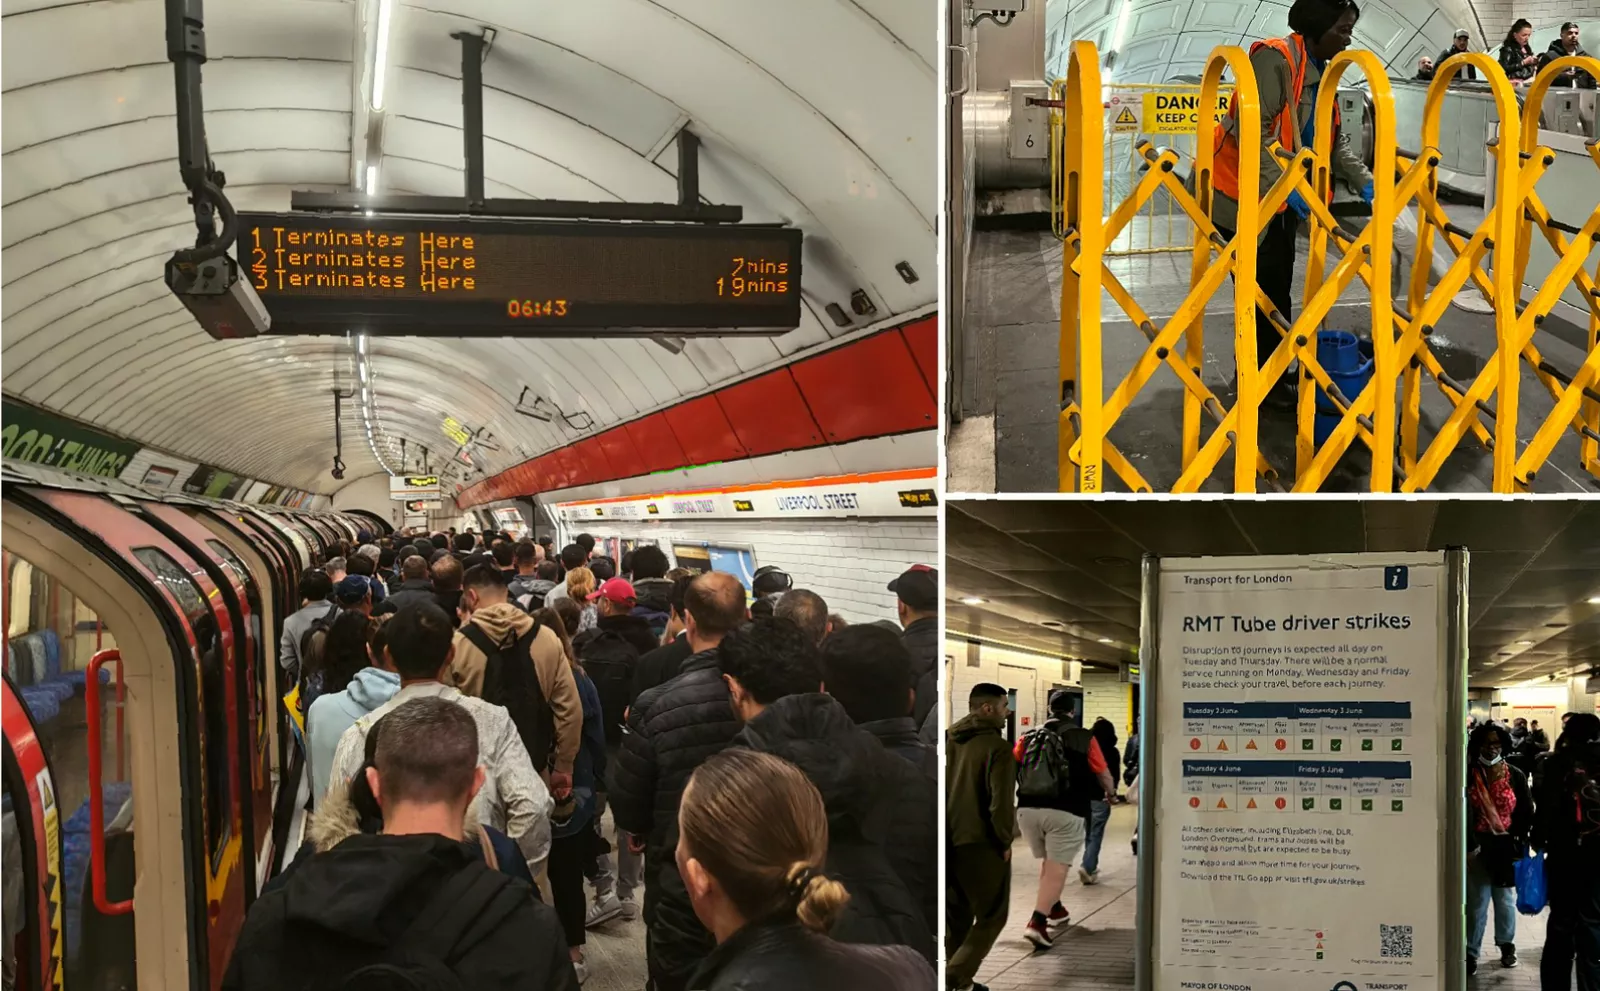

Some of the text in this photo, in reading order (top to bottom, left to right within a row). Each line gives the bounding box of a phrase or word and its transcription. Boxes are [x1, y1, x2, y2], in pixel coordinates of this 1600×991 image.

[1156, 96, 1228, 109] DANR
[1156, 114, 1186, 123] KEEP
[1026, 134, 1034, 148] 6
[252, 227, 474, 251] 1 Terminates Here
[252, 248, 267, 268] 2
[274, 249, 404, 268] Terminates
[420, 252, 475, 272] Here
[252, 268, 268, 290] 3
[275, 269, 405, 290] Terminates
[420, 271, 475, 292] Here
[508, 300, 567, 317] 06:43
[775, 493, 860, 510] LIVERPOOL STREET
[1184, 574, 1292, 586] Transport for London
[1183, 613, 1411, 632] RMT Tube driver strikes
[1243, 646, 1281, 655] journeys
[1294, 645, 1335, 654] expected
[1338, 644, 1349, 652] all
[1352, 645, 1368, 654] day
[1184, 657, 1218, 666] Tuesday
[1221, 657, 1237, 665] and
[1285, 656, 1310, 665] There
[1215, 669, 1250, 678] running
[1306, 668, 1359, 677] Wednesday
[1361, 668, 1378, 676] and
[1182, 681, 1211, 689] Please
[1213, 680, 1238, 688] check
[1241, 681, 1261, 690] your
[1263, 680, 1289, 688] travel
[1292, 680, 1321, 688] before
[1324, 680, 1346, 688] each
[1187, 707, 1214, 715] Tuesday
[1187, 765, 1217, 773] Thursday
[1298, 765, 1319, 774] Friday
[1276, 846, 1309, 854] expected
[1219, 873, 1232, 881] the
[1260, 875, 1273, 883] app
[1181, 982, 1206, 990] MAYOR
[1365, 983, 1408, 991] TRANSPORT
